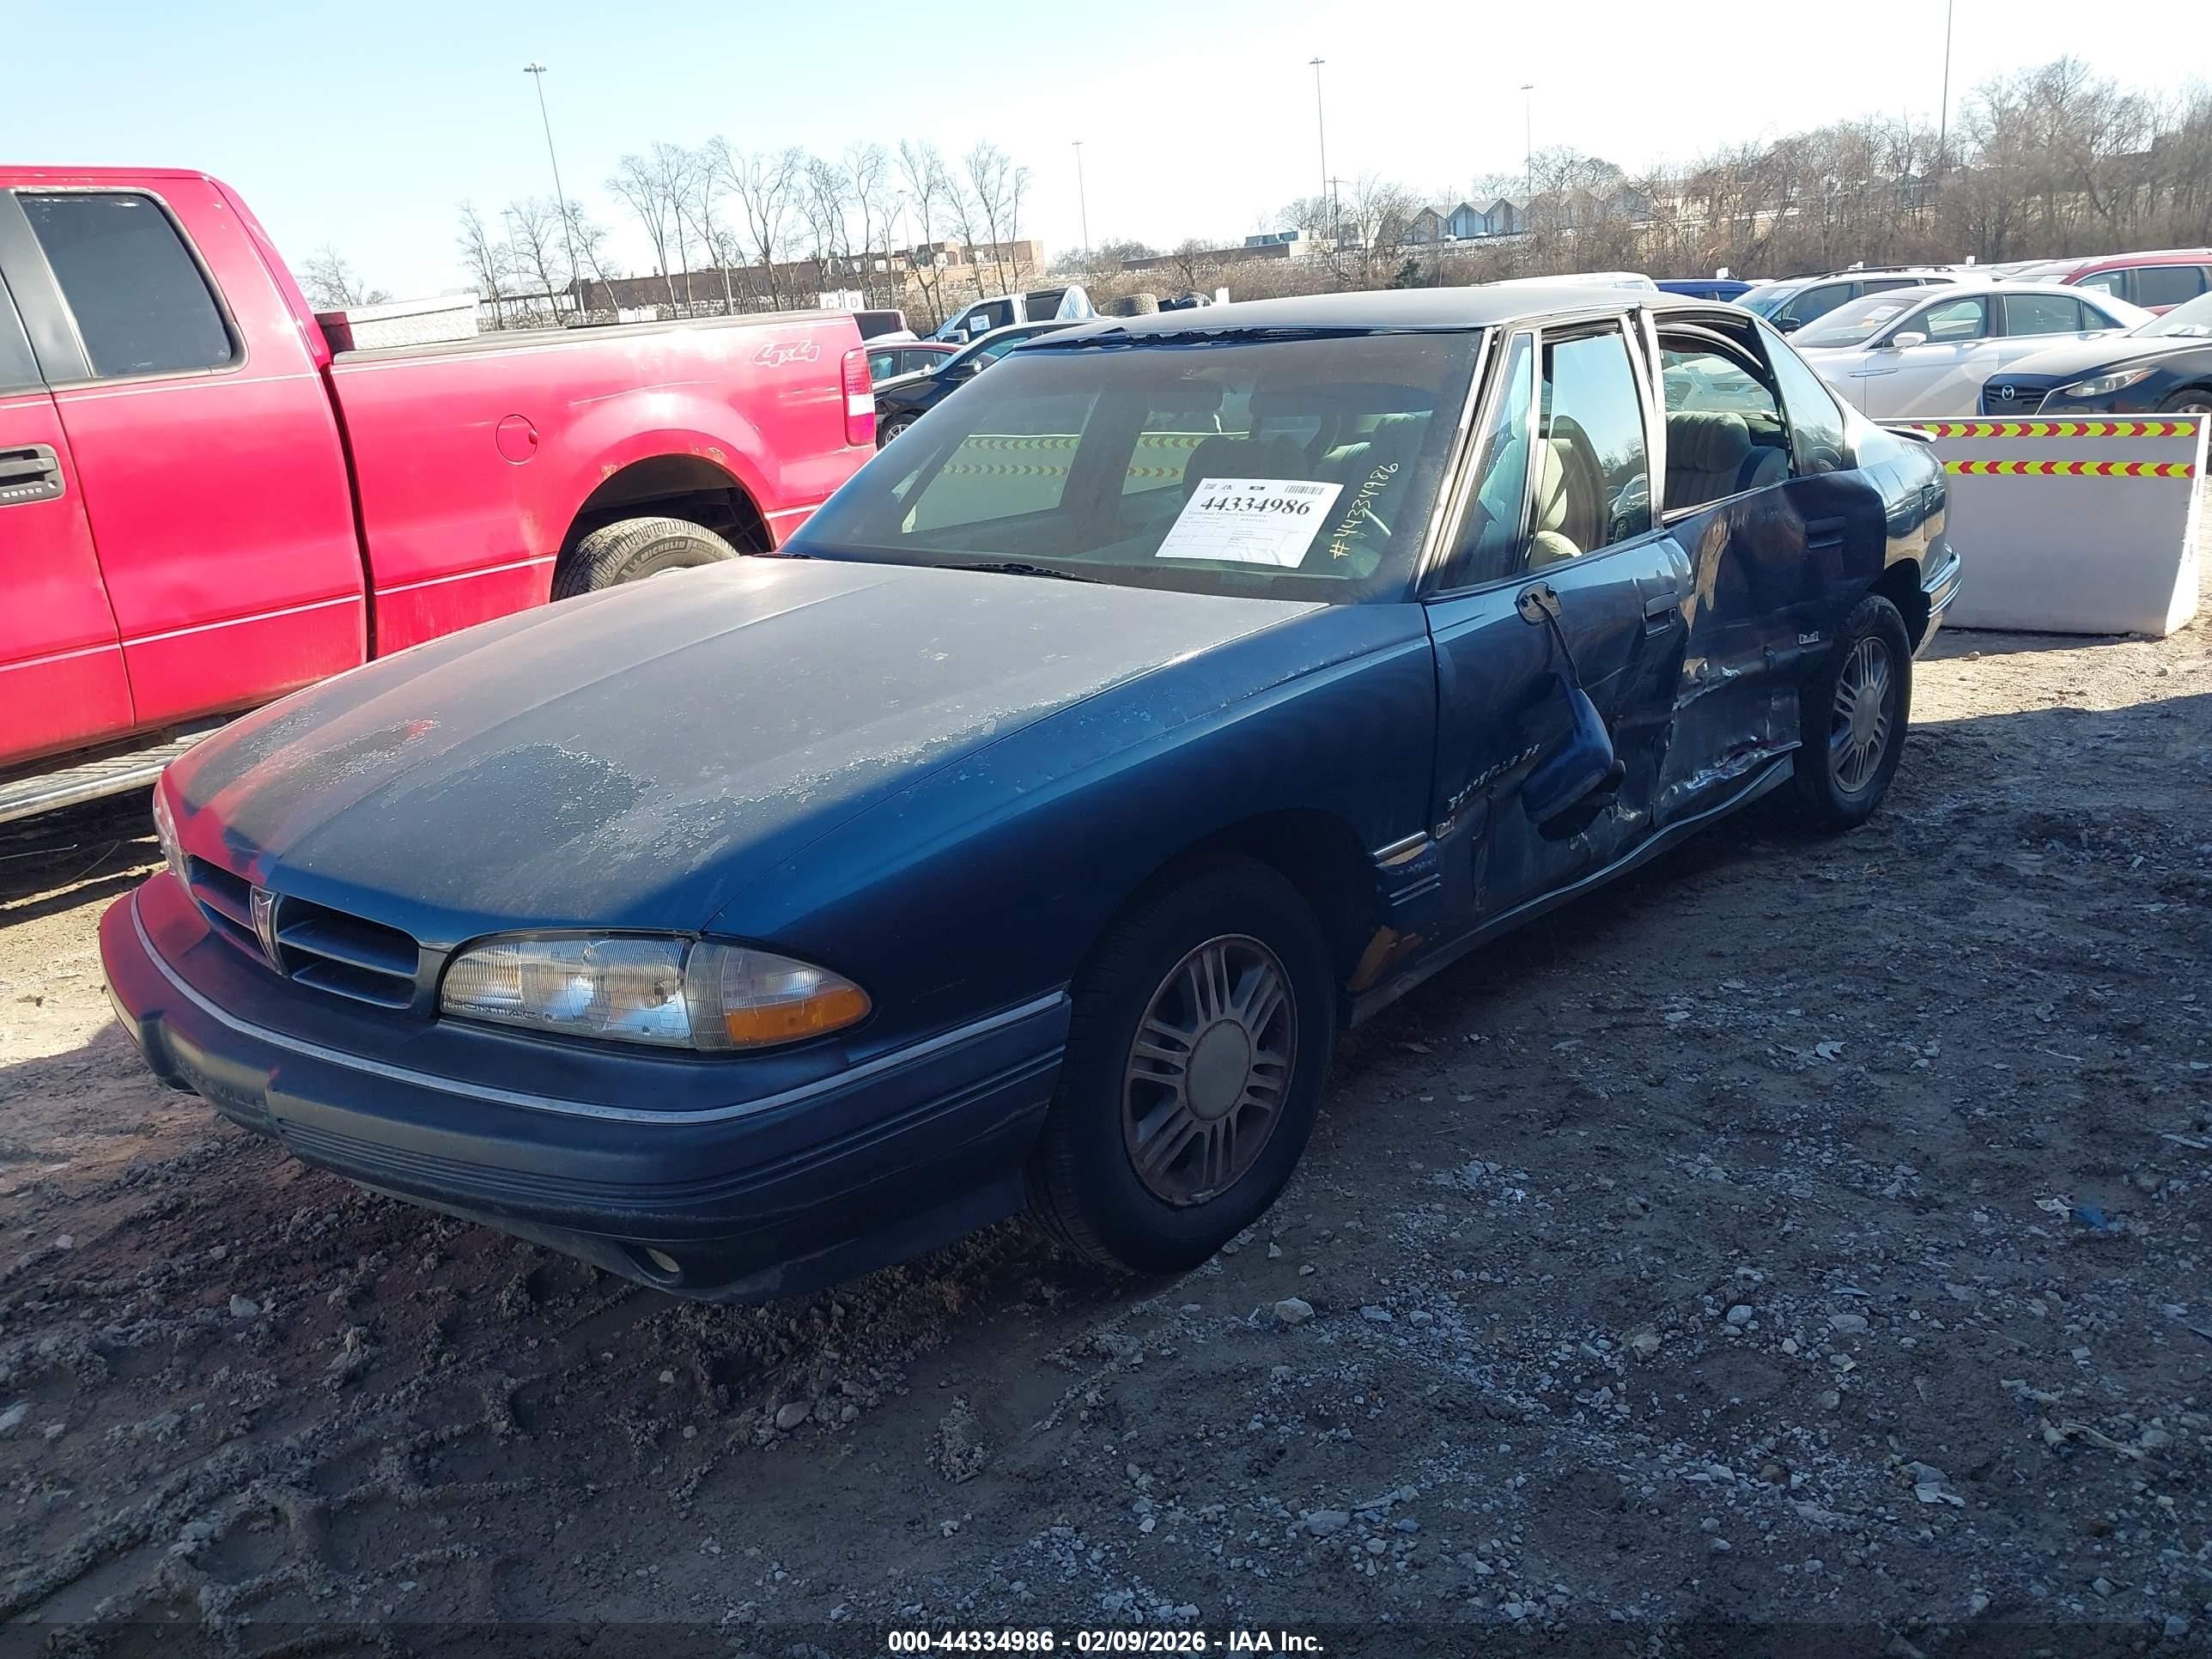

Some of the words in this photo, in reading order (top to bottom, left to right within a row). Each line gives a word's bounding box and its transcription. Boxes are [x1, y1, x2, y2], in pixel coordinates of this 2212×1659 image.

[850, 296, 859, 308] D
[1200, 496, 1316, 516] 44334986
[1328, 463, 1399, 560] #44334986
